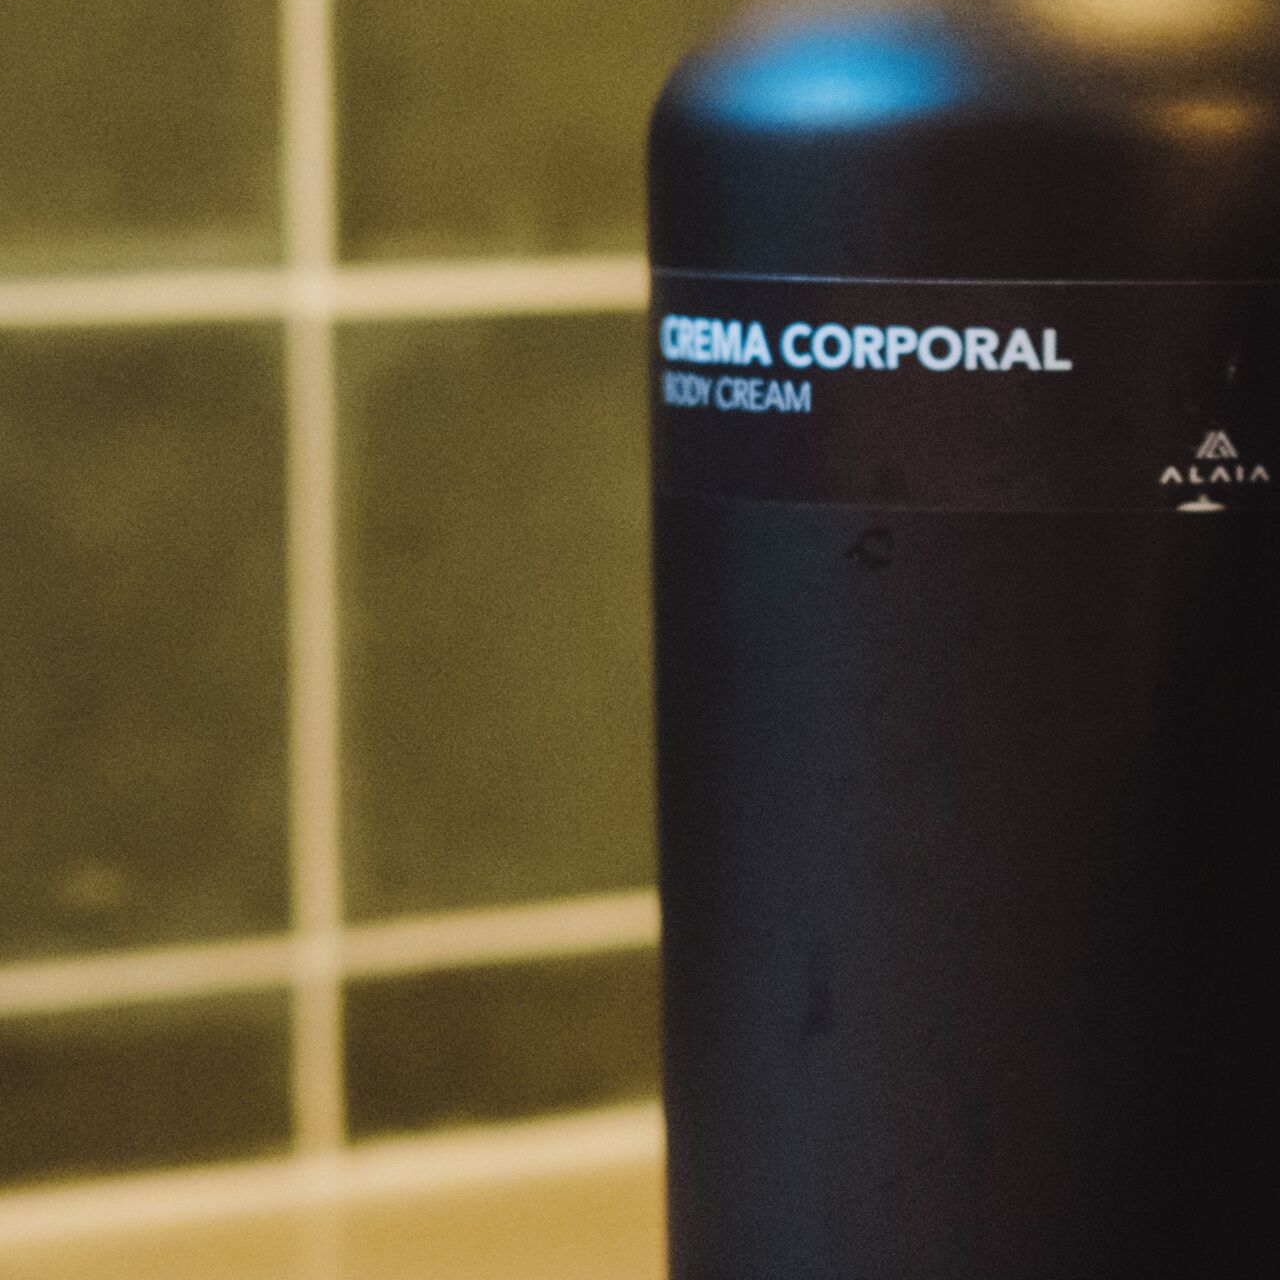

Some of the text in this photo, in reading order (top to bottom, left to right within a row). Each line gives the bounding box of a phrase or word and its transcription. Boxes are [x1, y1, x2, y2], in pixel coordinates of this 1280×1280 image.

[661, 313, 1073, 371] CREMA CORPORAL
[715, 376, 812, 413] CREAM
[1159, 465, 1270, 485] ALAIA
